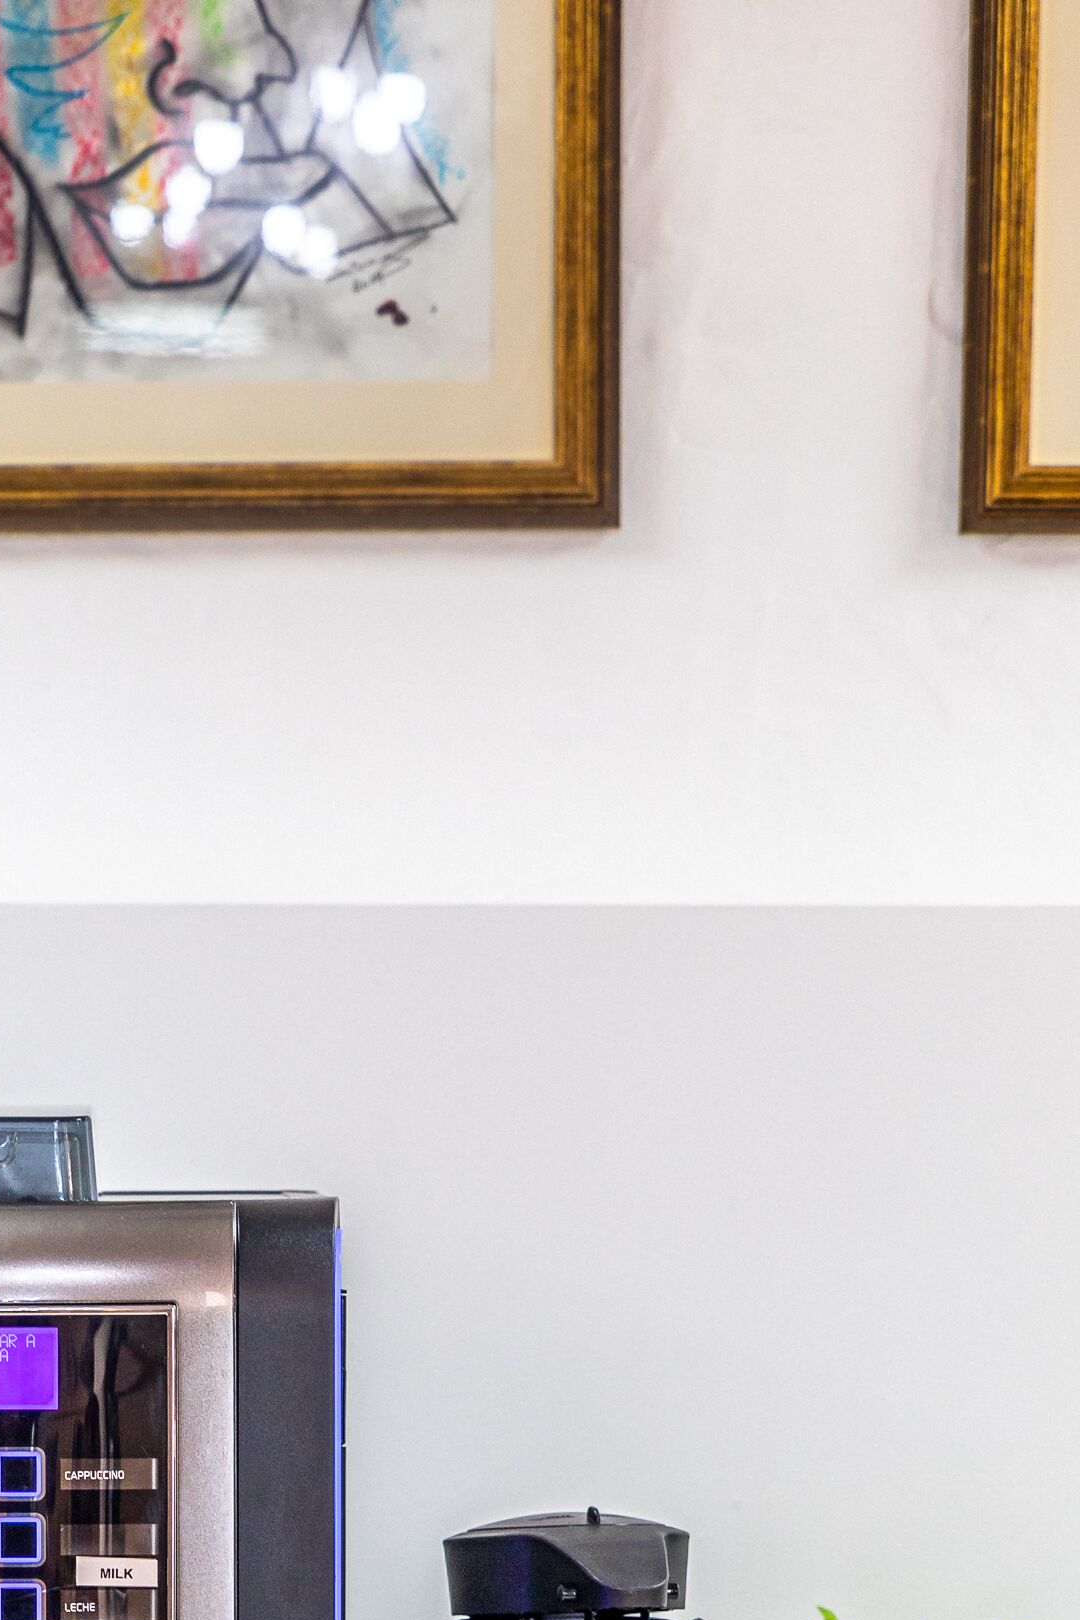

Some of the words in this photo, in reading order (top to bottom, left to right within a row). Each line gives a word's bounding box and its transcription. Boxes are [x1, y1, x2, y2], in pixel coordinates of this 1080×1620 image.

[25, 1333, 36, 1348] A
[64, 1470, 125, 1480] CAPPUCCINO
[100, 1568, 133, 1579] MILK
[64, 1602, 96, 1612] LECHE
